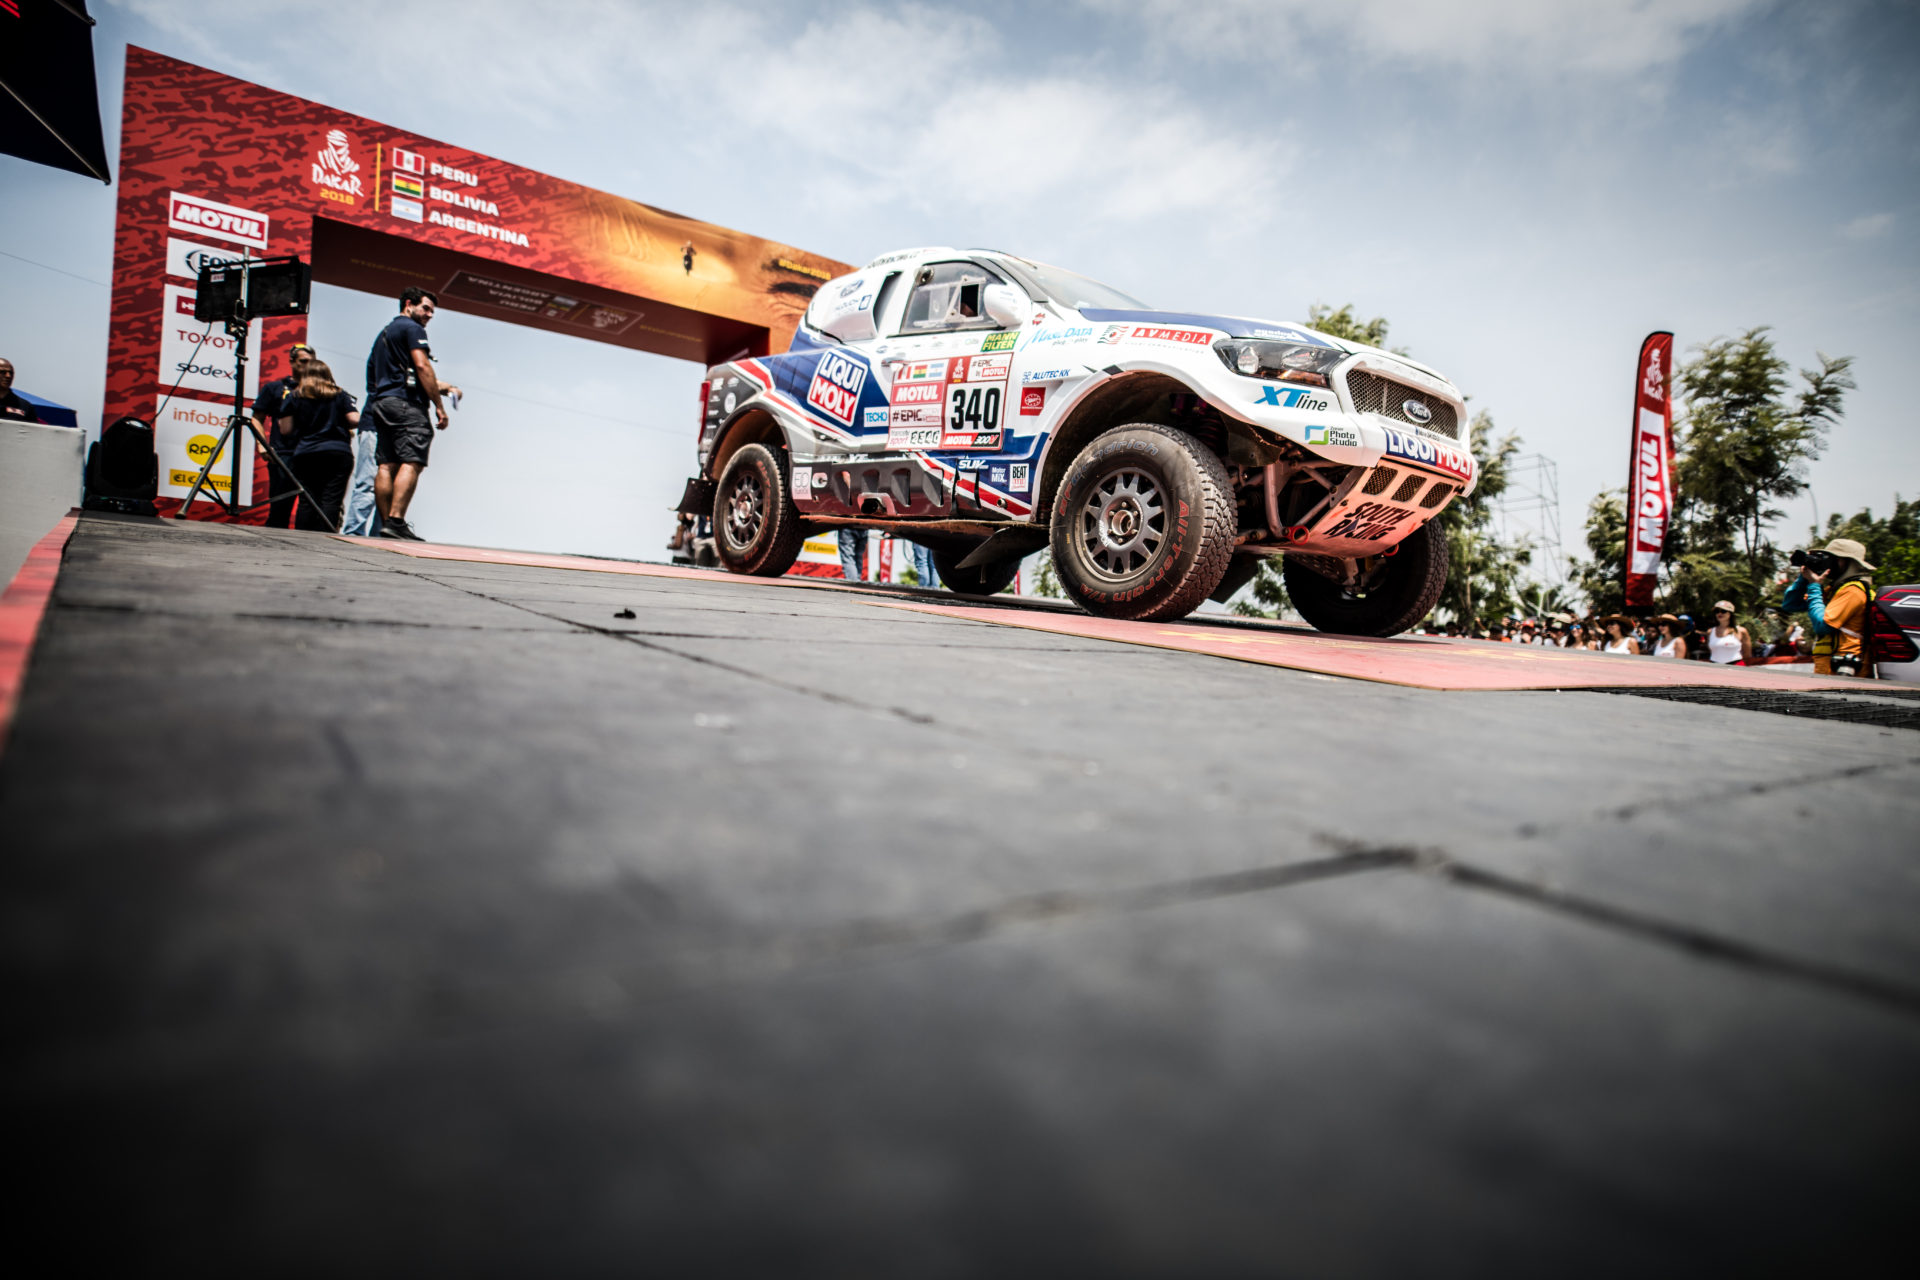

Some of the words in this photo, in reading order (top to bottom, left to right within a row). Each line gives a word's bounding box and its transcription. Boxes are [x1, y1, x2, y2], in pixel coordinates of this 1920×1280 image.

[312, 163, 364, 197] DAKAR
[430, 162, 478, 187] PERU
[320, 188, 354, 206] 2018
[429, 185, 499, 217] BOLIVIA
[176, 204, 262, 238] MOTUL
[428, 210, 530, 248] ARGENTINA
[177, 329, 236, 350] TOYOT
[983, 340, 1015, 351] FILTER
[986, 332, 1018, 342] MANN
[819, 353, 864, 393] LIQUI
[984, 368, 1006, 376] MOTUL
[811, 377, 857, 419] MOLY
[895, 385, 939, 402] MOTUL
[173, 408, 230, 428] infoba
[866, 411, 888, 423] TECHO
[951, 387, 1000, 430] 340
[944, 436, 972, 445] MOTUL
[973, 435, 999, 444] 300V
[1330, 431, 1355, 439] Photo
[1330, 438, 1357, 446] Studio
[1384, 428, 1436, 462] LIQUI
[1012, 466, 1027, 479] BEAT
[1639, 439, 1664, 547] MOTUL
[1344, 502, 1416, 525] SOUTH
